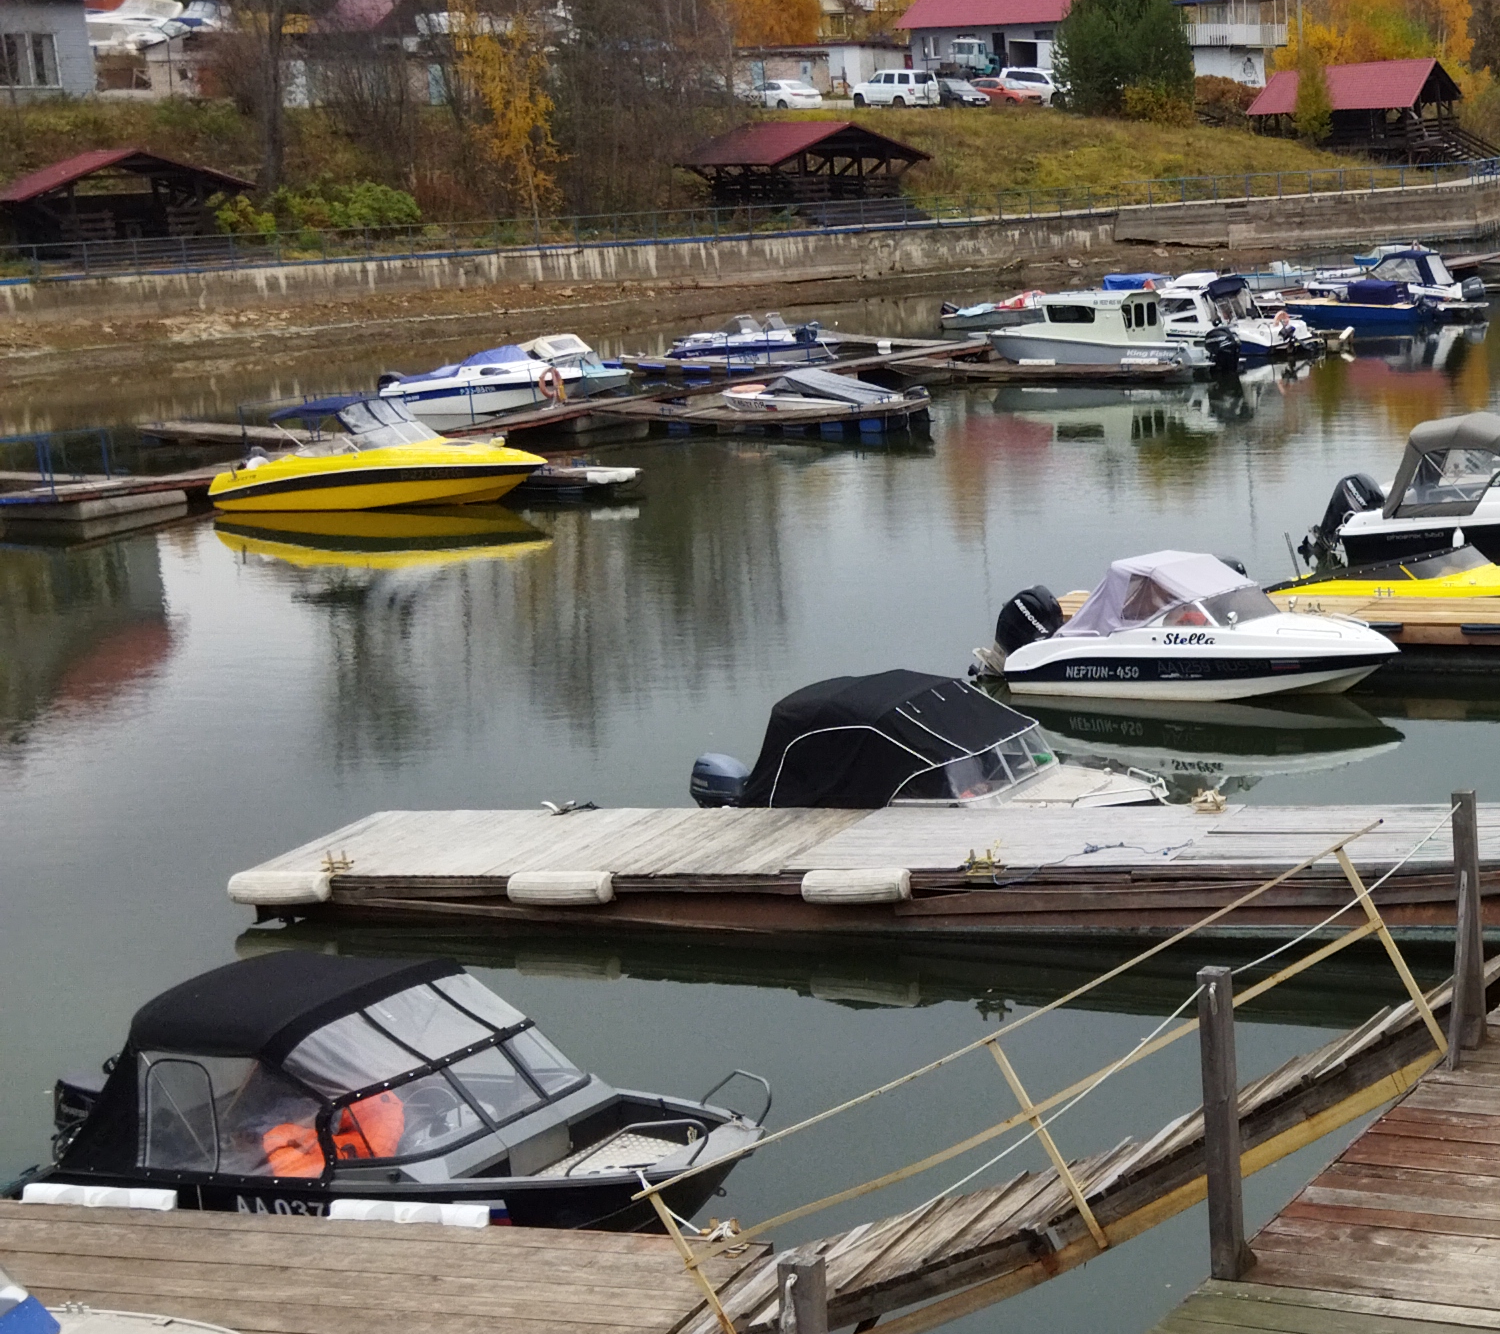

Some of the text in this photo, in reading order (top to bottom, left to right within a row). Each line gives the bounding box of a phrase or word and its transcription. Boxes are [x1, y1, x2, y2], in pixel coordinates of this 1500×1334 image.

[1126, 349, 1175, 358] King Fishe
[1014, 598, 1049, 635] MERCURY
[1163, 632, 1216, 646] Stella
